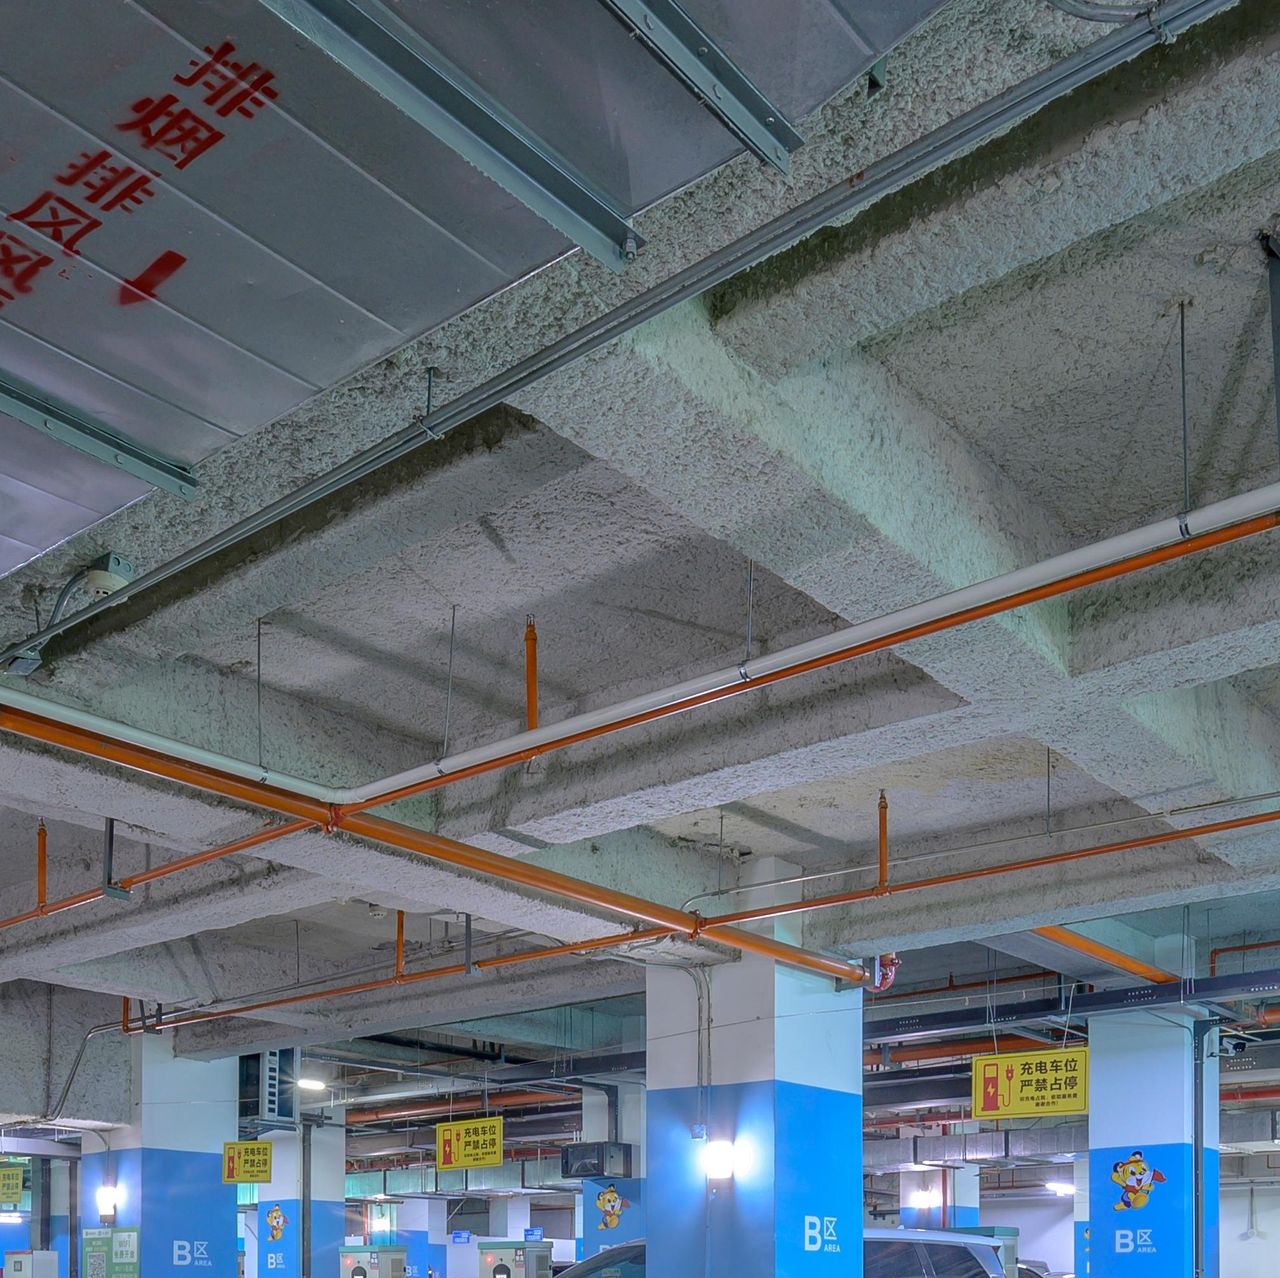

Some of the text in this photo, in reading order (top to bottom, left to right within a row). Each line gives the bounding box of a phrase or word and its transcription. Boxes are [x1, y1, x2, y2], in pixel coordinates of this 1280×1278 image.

[1020, 1058, 1078, 1076] 充电车位
[1020, 1076, 1078, 1093] 严禁占停
[464, 1125, 496, 1138] 充电车位
[464, 1138, 496, 1151] 严禁占停
[804, 1215, 837, 1252] B区
[1115, 1229, 1152, 1253] B区
[173, 1240, 208, 1265] B区
[824, 1244, 841, 1252] AREA
